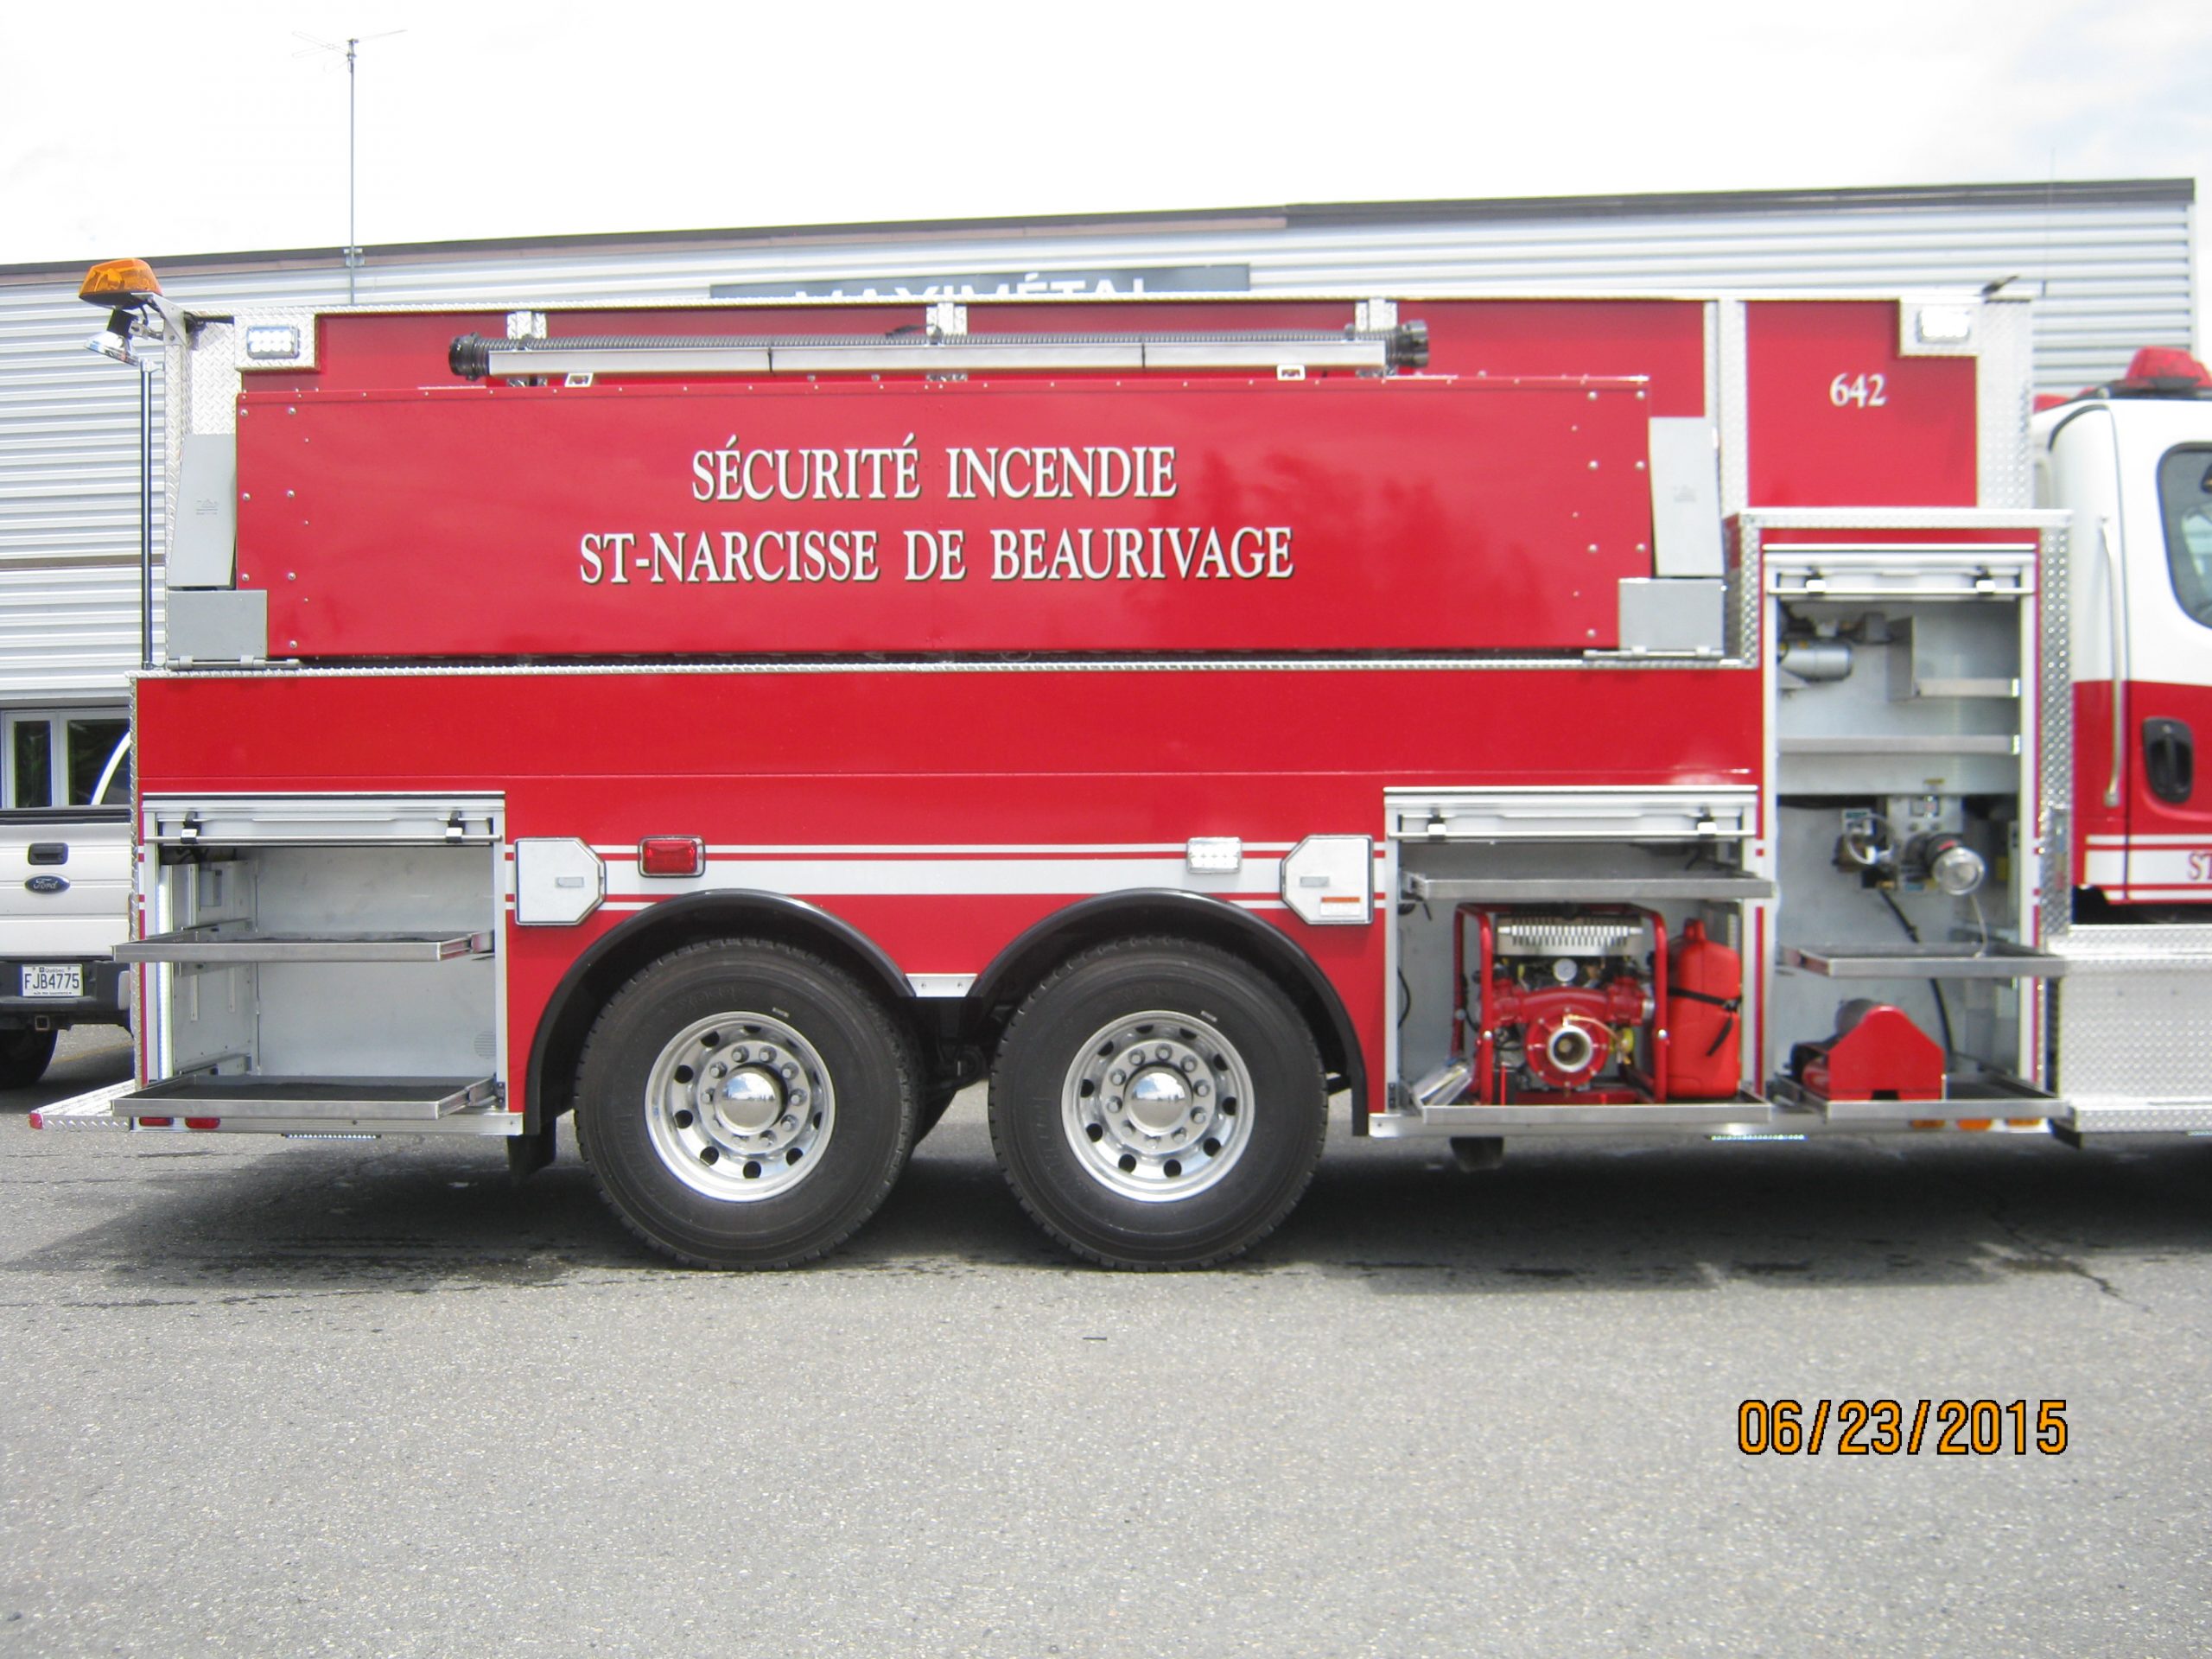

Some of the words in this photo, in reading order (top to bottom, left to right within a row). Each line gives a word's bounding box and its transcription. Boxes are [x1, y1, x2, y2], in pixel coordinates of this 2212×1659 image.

[1829, 373, 1887, 409] 642
[692, 432, 921, 502] SÉCURITÉ
[945, 446, 1178, 500] INCENDIE
[580, 530, 880, 585] ST-NARCISSE
[903, 530, 967, 582] DE
[989, 526, 1294, 581] BEAURIVAGE
[24, 973, 79, 989] FJB4775
